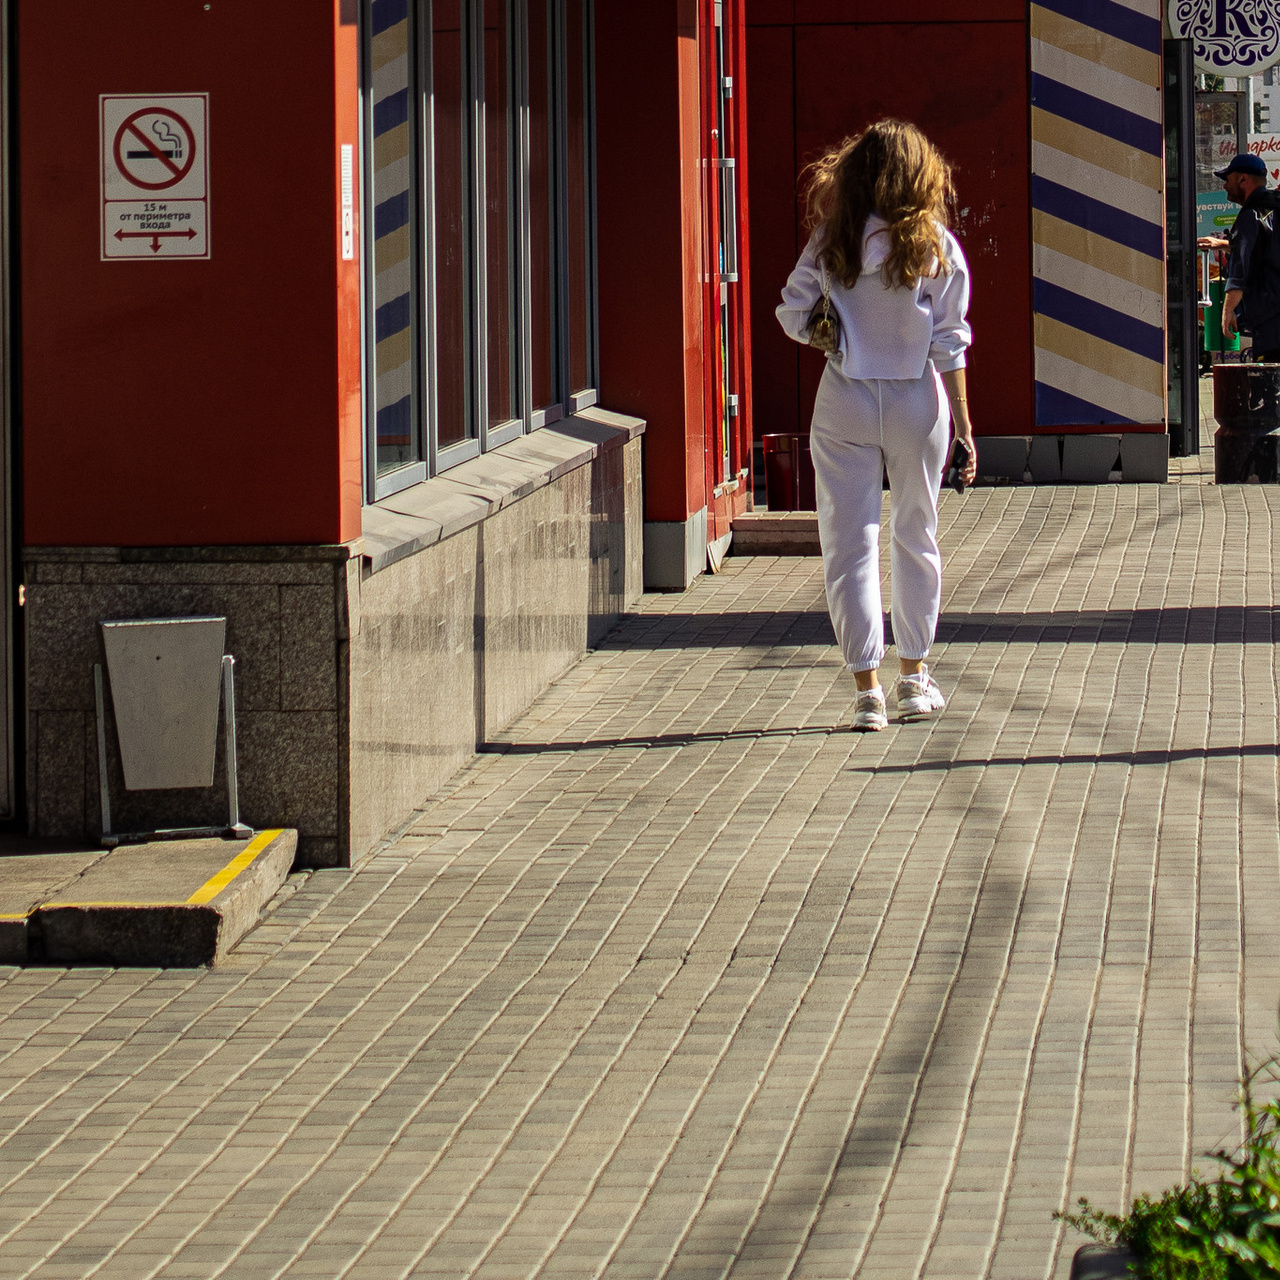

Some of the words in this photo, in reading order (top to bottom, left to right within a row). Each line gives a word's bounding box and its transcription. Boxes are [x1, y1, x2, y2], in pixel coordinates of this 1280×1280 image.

[143, 203, 157, 212] 15
[119, 214, 132, 222] от
[133, 212, 191, 223] периметра
[139, 220, 171, 231] входа
